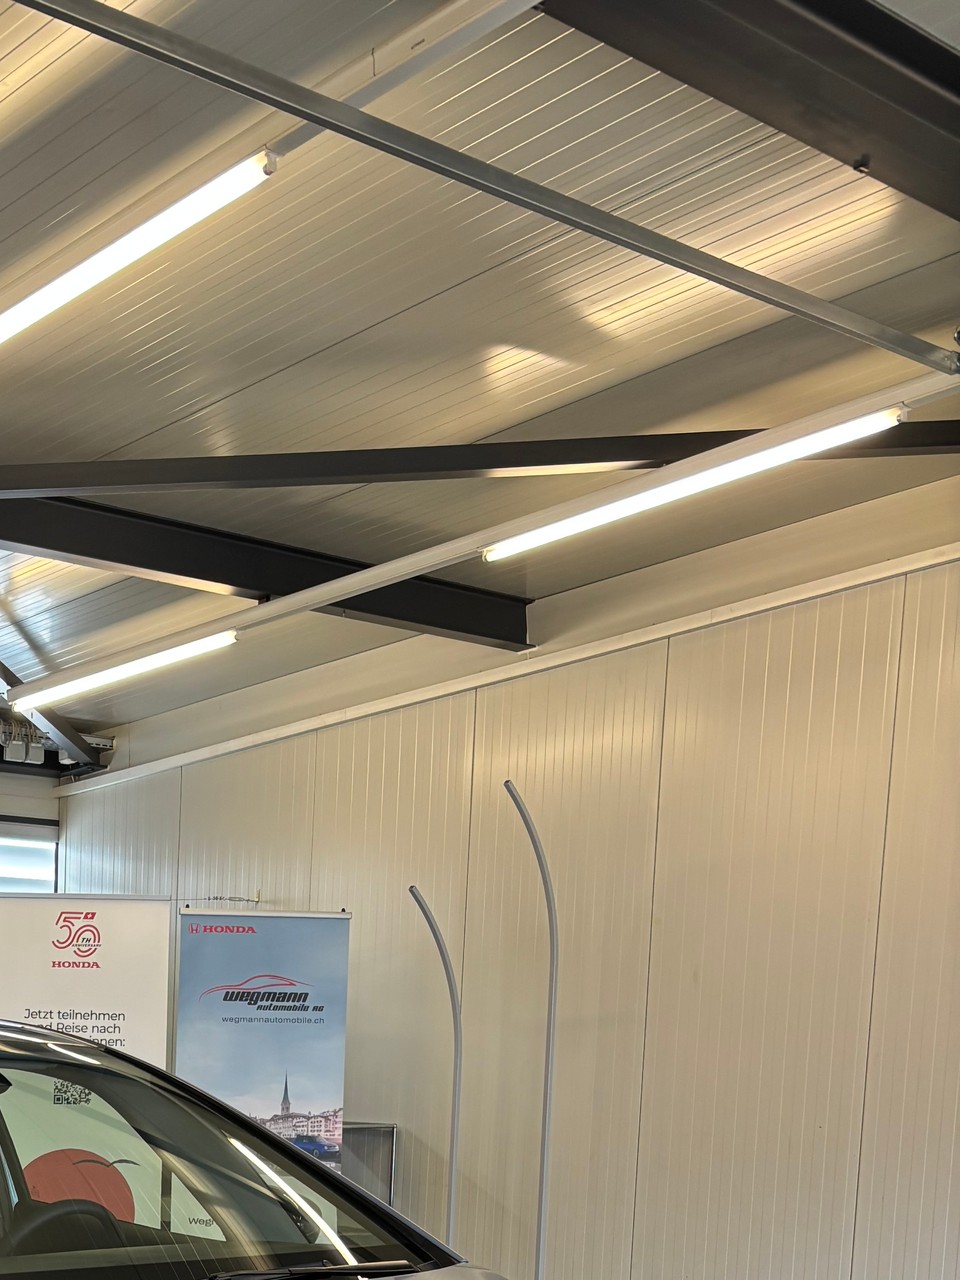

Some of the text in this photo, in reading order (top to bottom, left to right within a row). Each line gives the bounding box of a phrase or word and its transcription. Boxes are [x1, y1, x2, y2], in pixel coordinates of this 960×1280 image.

[51, 911, 101, 958] 50
[203, 925, 256, 934] HONDA
[222, 991, 309, 1005] wegmann
[24, 1008, 125, 1021] Jetzt teilnehmen
[221, 1016, 325, 1025] wegmannautomobile.ch
[56, 1022, 88, 1033] Reise
[92, 1023, 121, 1034] nach
[188, 1217, 214, 1227] Weg
